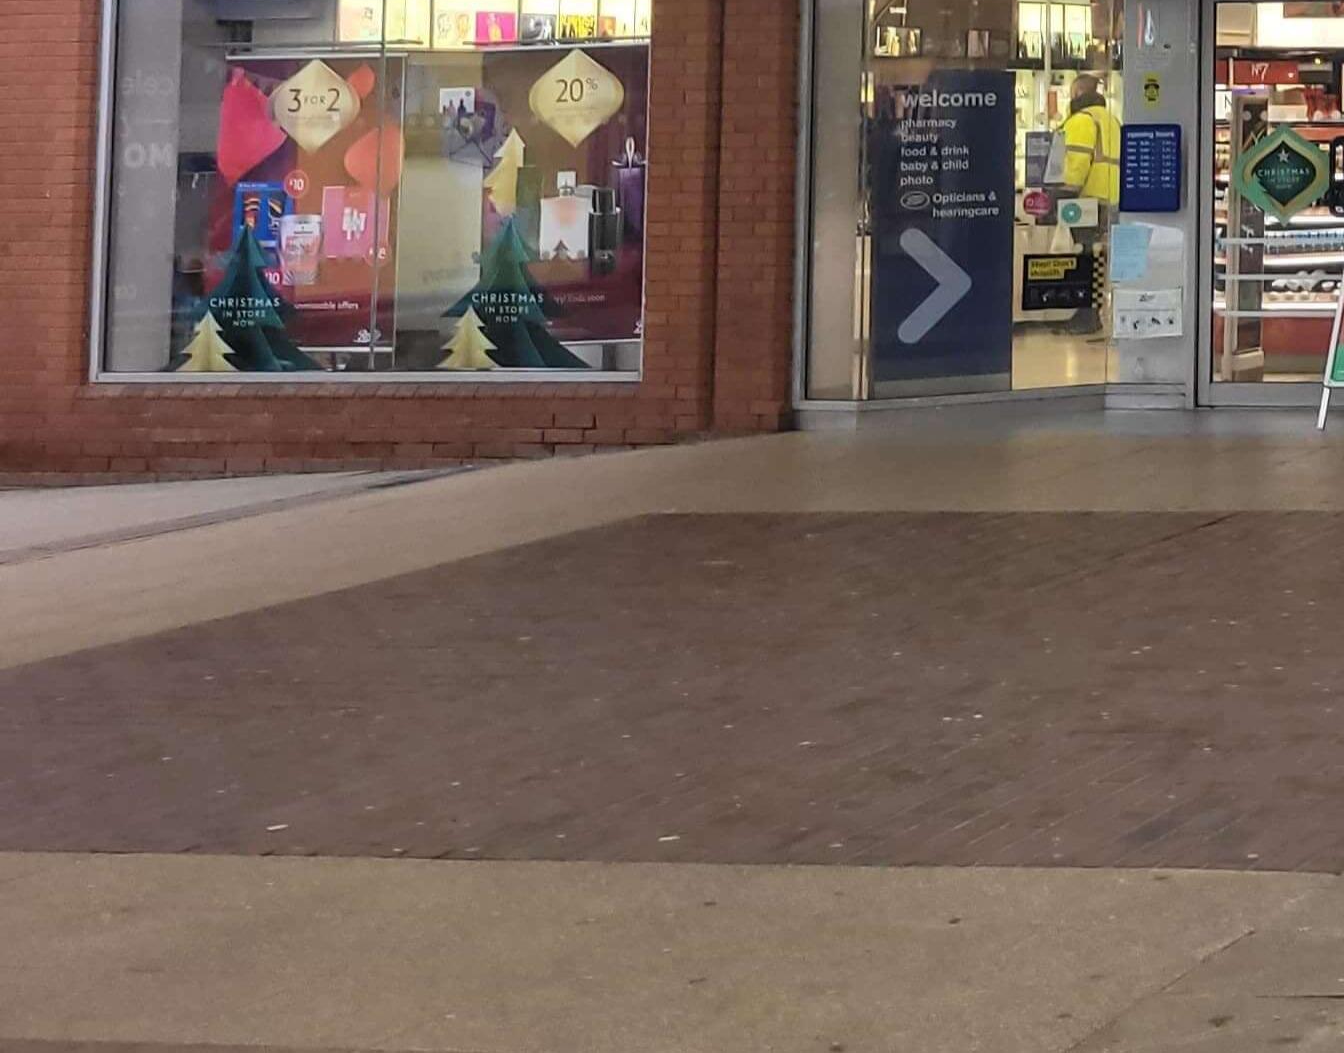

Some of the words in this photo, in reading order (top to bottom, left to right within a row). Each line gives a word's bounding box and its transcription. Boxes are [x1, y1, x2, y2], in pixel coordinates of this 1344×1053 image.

[555, 78, 598, 103] 20%
[288, 88, 301, 113] 3
[304, 96, 326, 105] FOR
[327, 88, 340, 112] 2
[901, 89, 997, 107] welcome
[901, 118, 957, 129] pharmacy
[901, 131, 938, 143] beauty
[901, 147, 926, 156] food
[930, 147, 938, 156] &
[941, 145, 969, 156] drink
[901, 161, 928, 172] baby
[931, 161, 939, 170] &
[942, 160, 969, 169] child
[1258, 168, 1310, 178] CHRISTMAS
[901, 176, 934, 186] photo
[932, 192, 985, 204] Opticians
[932, 207, 1000, 218] hearingcare
[210, 298, 280, 308] CHRISTMAS
[472, 293, 544, 303] CHRISTMAS
[223, 310, 233, 318] IN
[236, 310, 266, 318] STORE
[484, 306, 496, 314] IN
[499, 305, 530, 314] STORE
[495, 315, 518, 323] NOW
